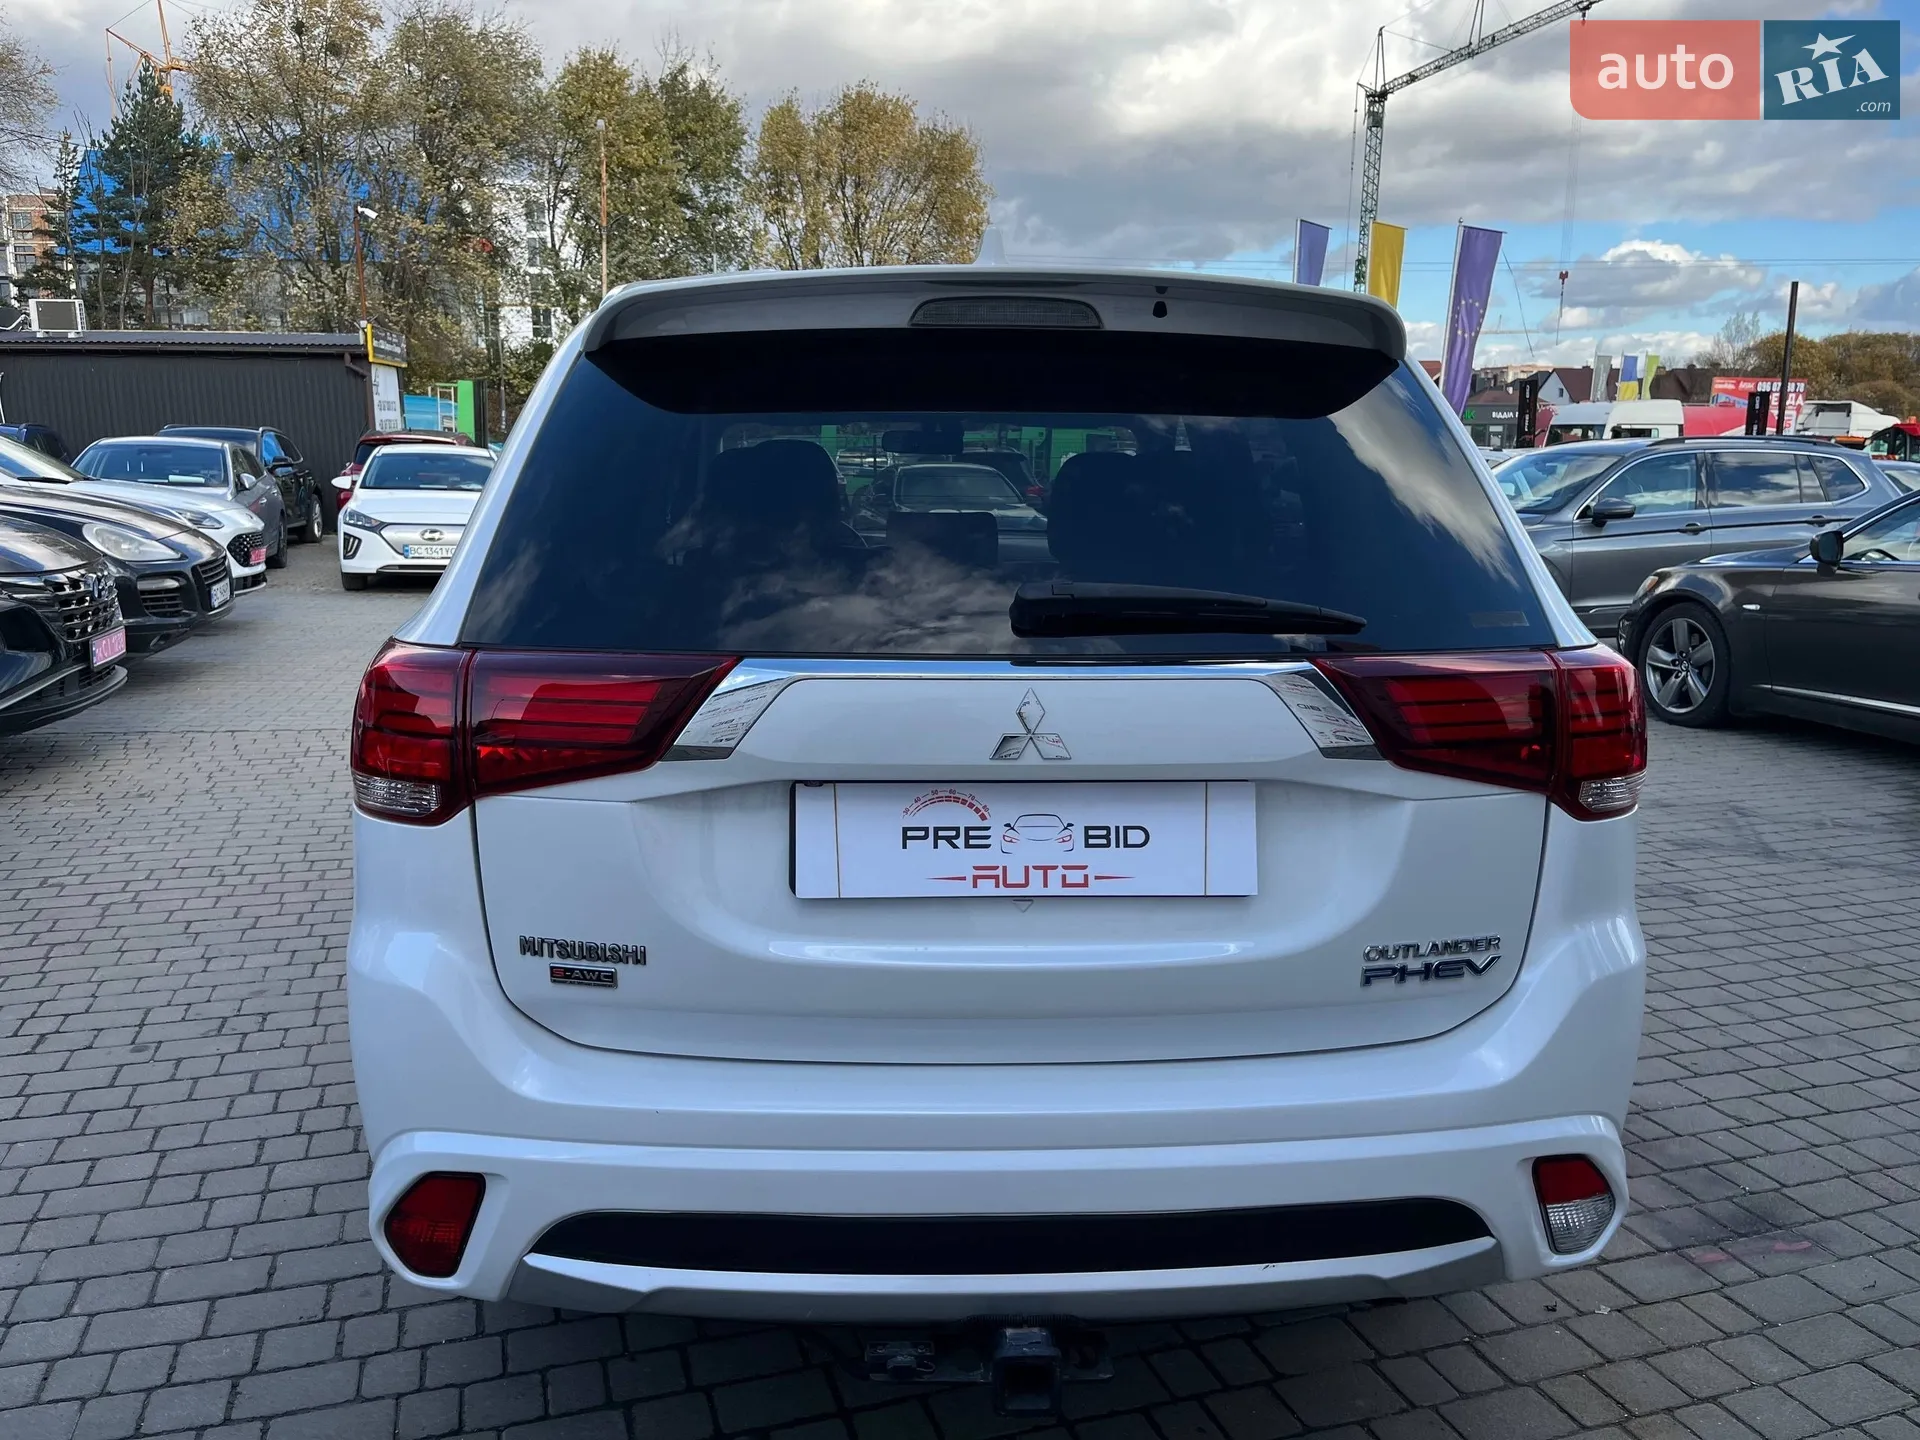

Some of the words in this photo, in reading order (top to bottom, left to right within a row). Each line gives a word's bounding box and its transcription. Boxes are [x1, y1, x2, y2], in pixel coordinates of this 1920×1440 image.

[967, 793, 976, 801] 70
[901, 825, 992, 850] PRE
[1083, 825, 1151, 849] BID
[972, 864, 1089, 889] AUTO
[519, 935, 647, 966] MITSUBISHI
[1362, 933, 1501, 962] OUTLANDER
[552, 968, 613, 982] S-AWC
[1360, 954, 1502, 987] PHEV
